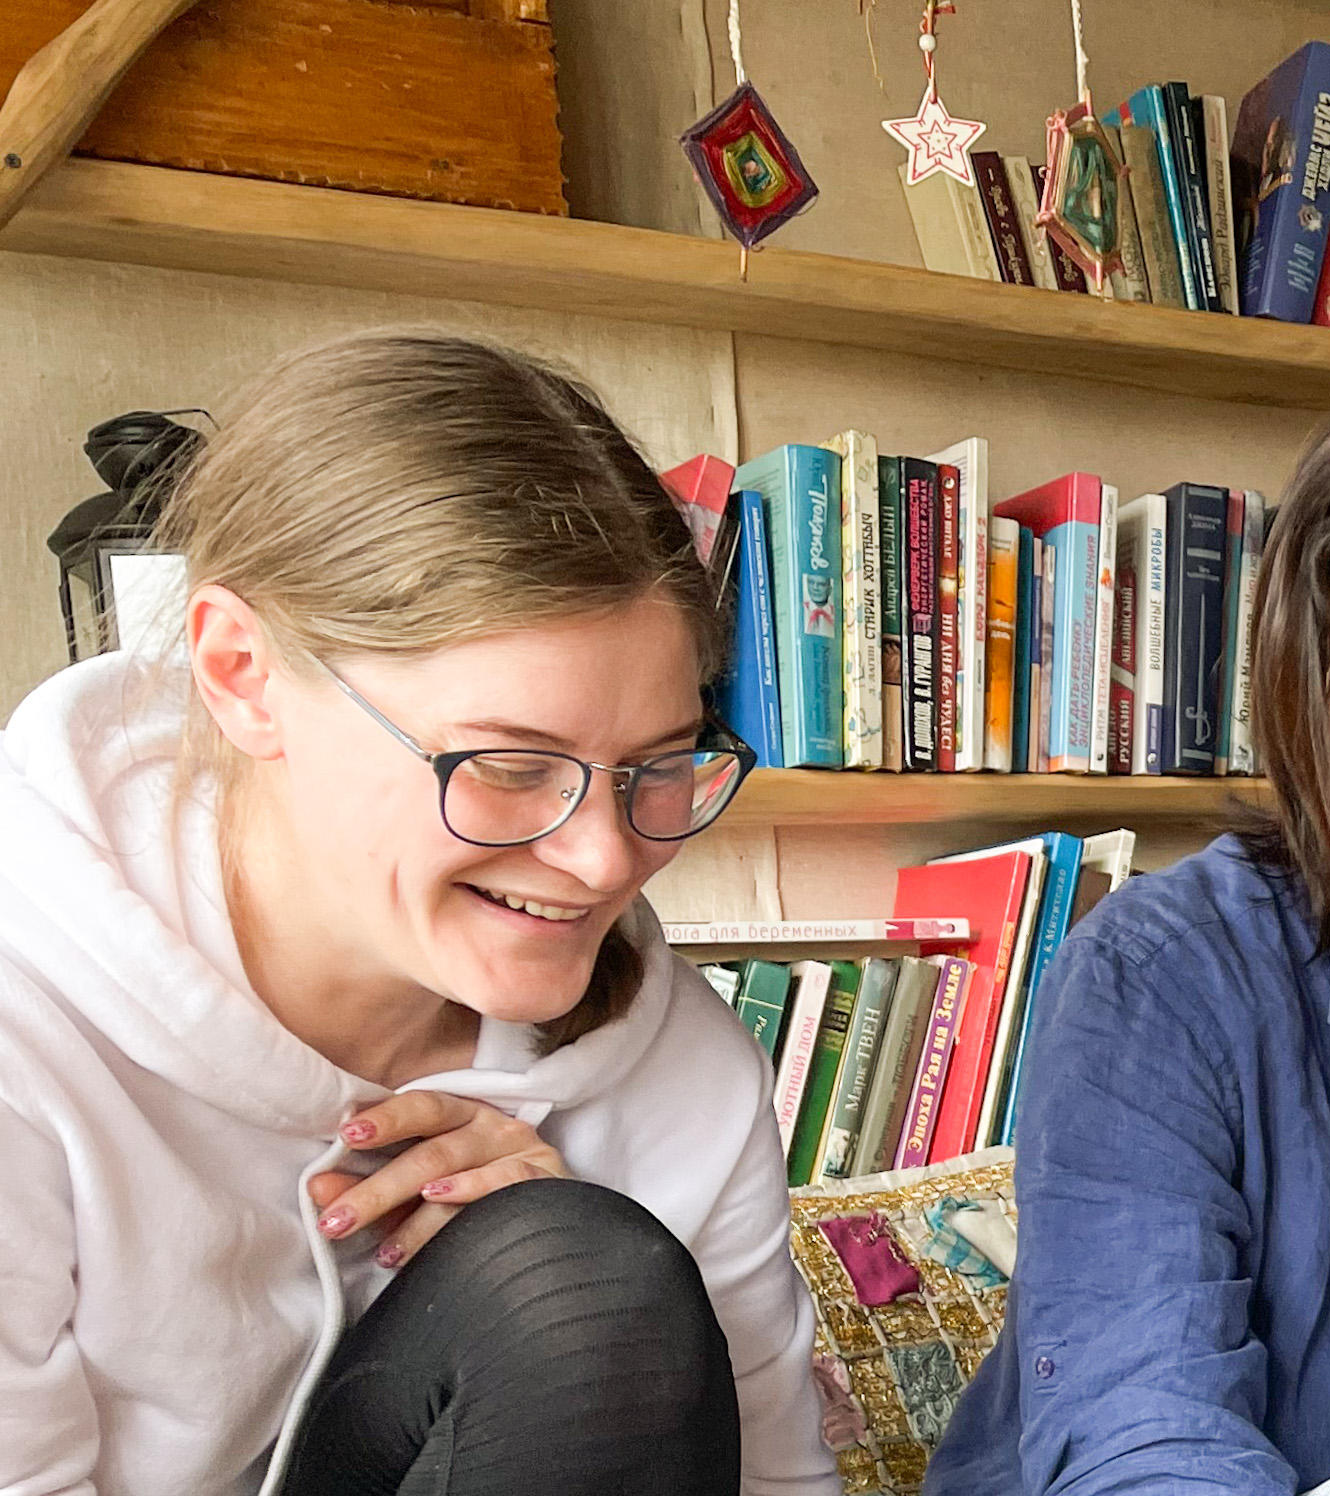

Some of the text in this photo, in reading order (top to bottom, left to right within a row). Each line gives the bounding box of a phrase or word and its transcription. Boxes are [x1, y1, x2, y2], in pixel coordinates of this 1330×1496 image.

[860, 512, 876, 584] ХОТТАБЫЧ
[880, 504, 898, 621] Андрей БЕЛЫЙ
[863, 588, 877, 641] СТАРИК
[941, 612, 953, 638] НИ
[1149, 526, 1163, 671] ВОЛШЕБНЫЕ МИКРОБЫ
[940, 639, 953, 674] ДНЯ
[1078, 534, 1097, 748] ЭНЦИКЛОПЕДИЧЕСКИЕ ЗНАНИЯ
[939, 698, 951, 751] ЧУДЕС!
[1069, 721, 1081, 747] КАК
[1118, 699, 1131, 765] РУССКИЙ
[709, 925, 740, 943] для
[748, 922, 858, 943] беременных
[777, 1015, 816, 1129] УЮТНЫЙ ДОМ
[844, 1006, 881, 1112] Марк ТВЕН
[907, 962, 963, 1153] Эпоха Рая на Земле
